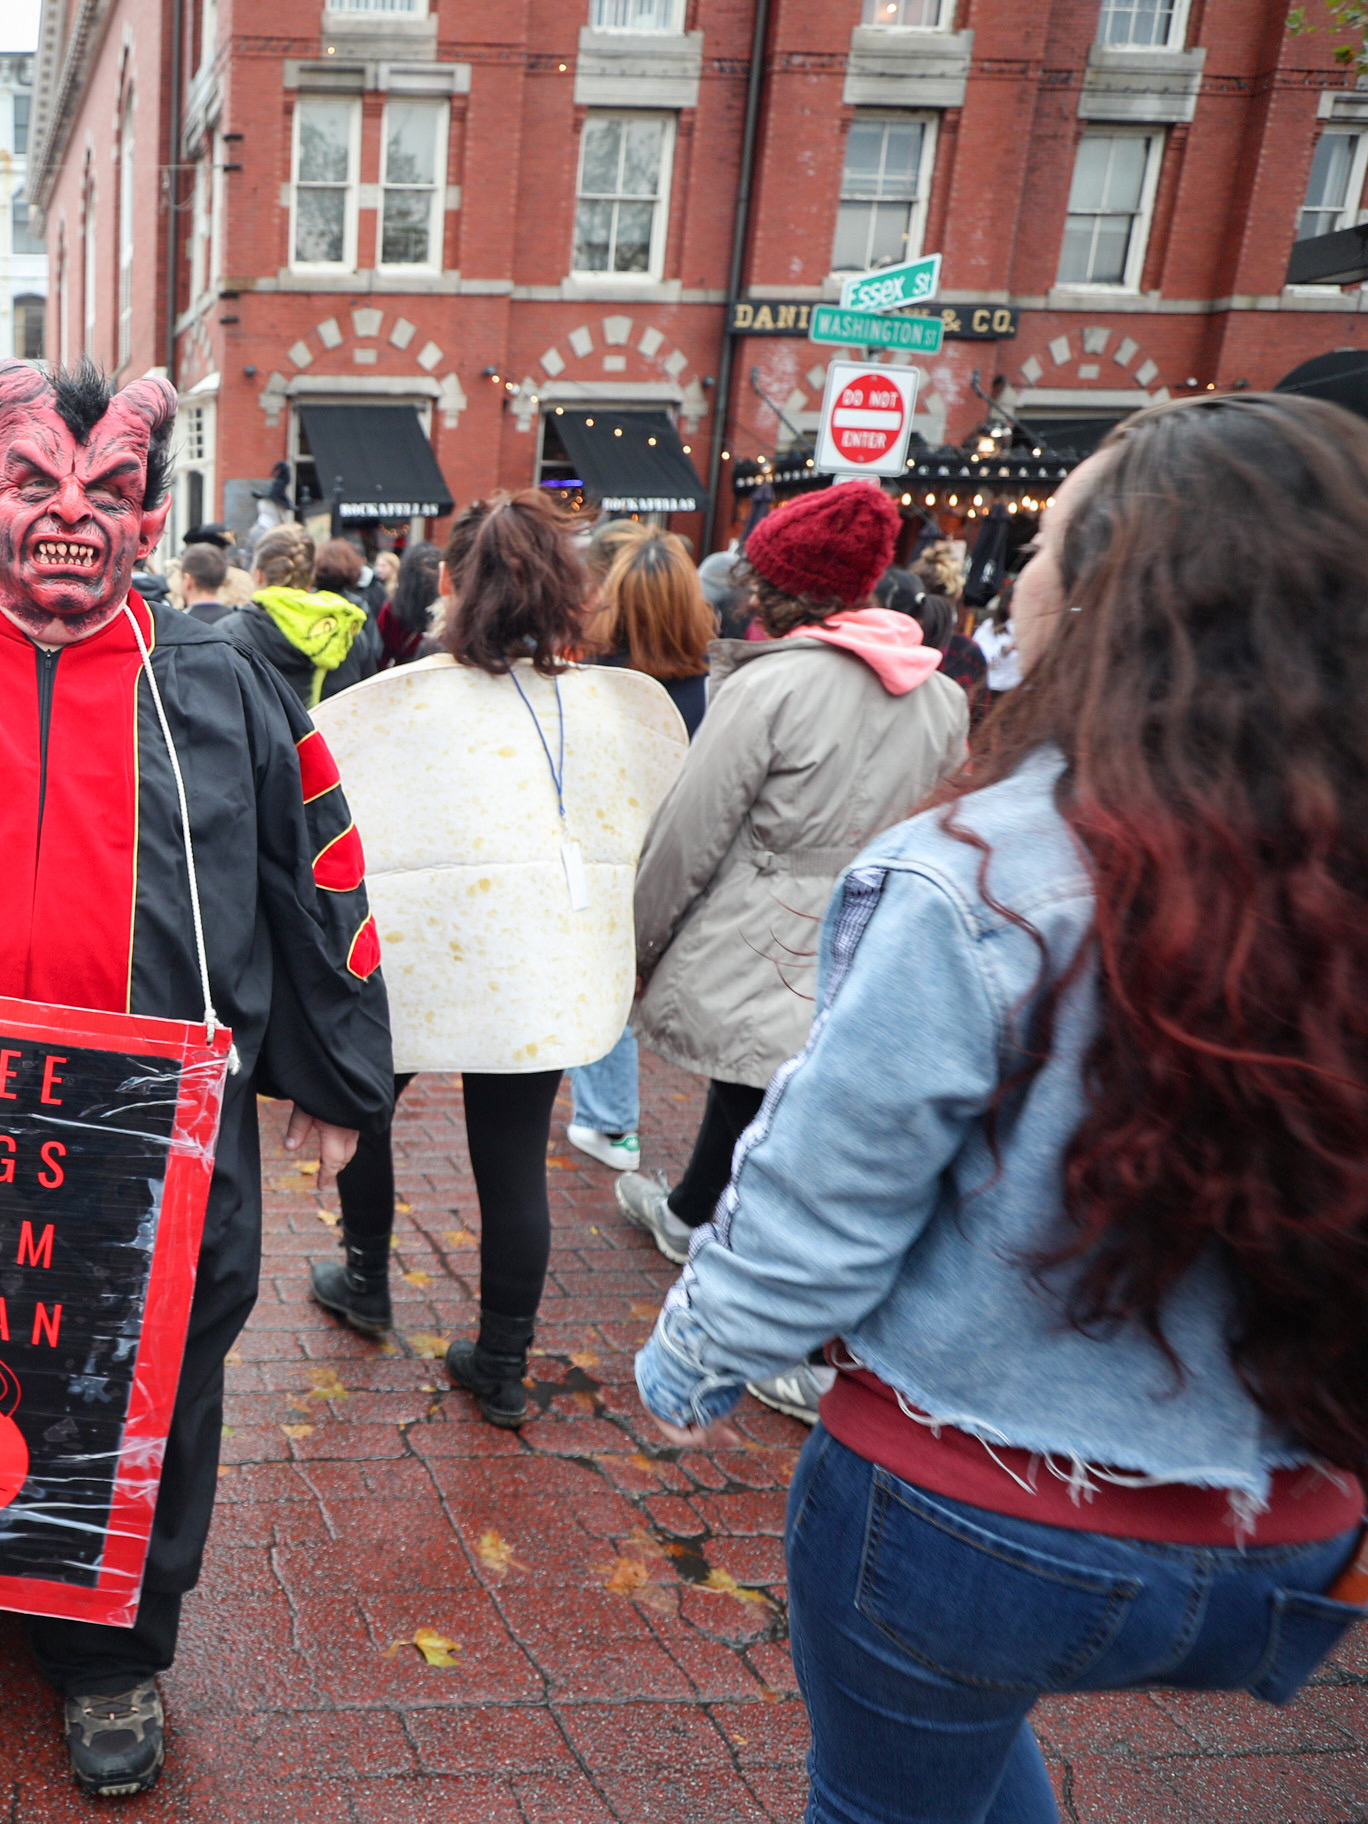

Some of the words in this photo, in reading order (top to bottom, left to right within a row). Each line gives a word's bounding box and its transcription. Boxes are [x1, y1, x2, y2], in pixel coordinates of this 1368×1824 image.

[847, 276, 906, 311] Essex
[913, 271, 932, 296] St
[734, 303, 810, 330] DANI
[941, 309, 961, 333] &
[972, 309, 1015, 334] CO.
[819, 313, 924, 345] WASHINGTON
[925, 329, 937, 346] ST
[842, 388, 864, 407] DO
[868, 390, 899, 409] NOT
[841, 430, 888, 449] ENTER
